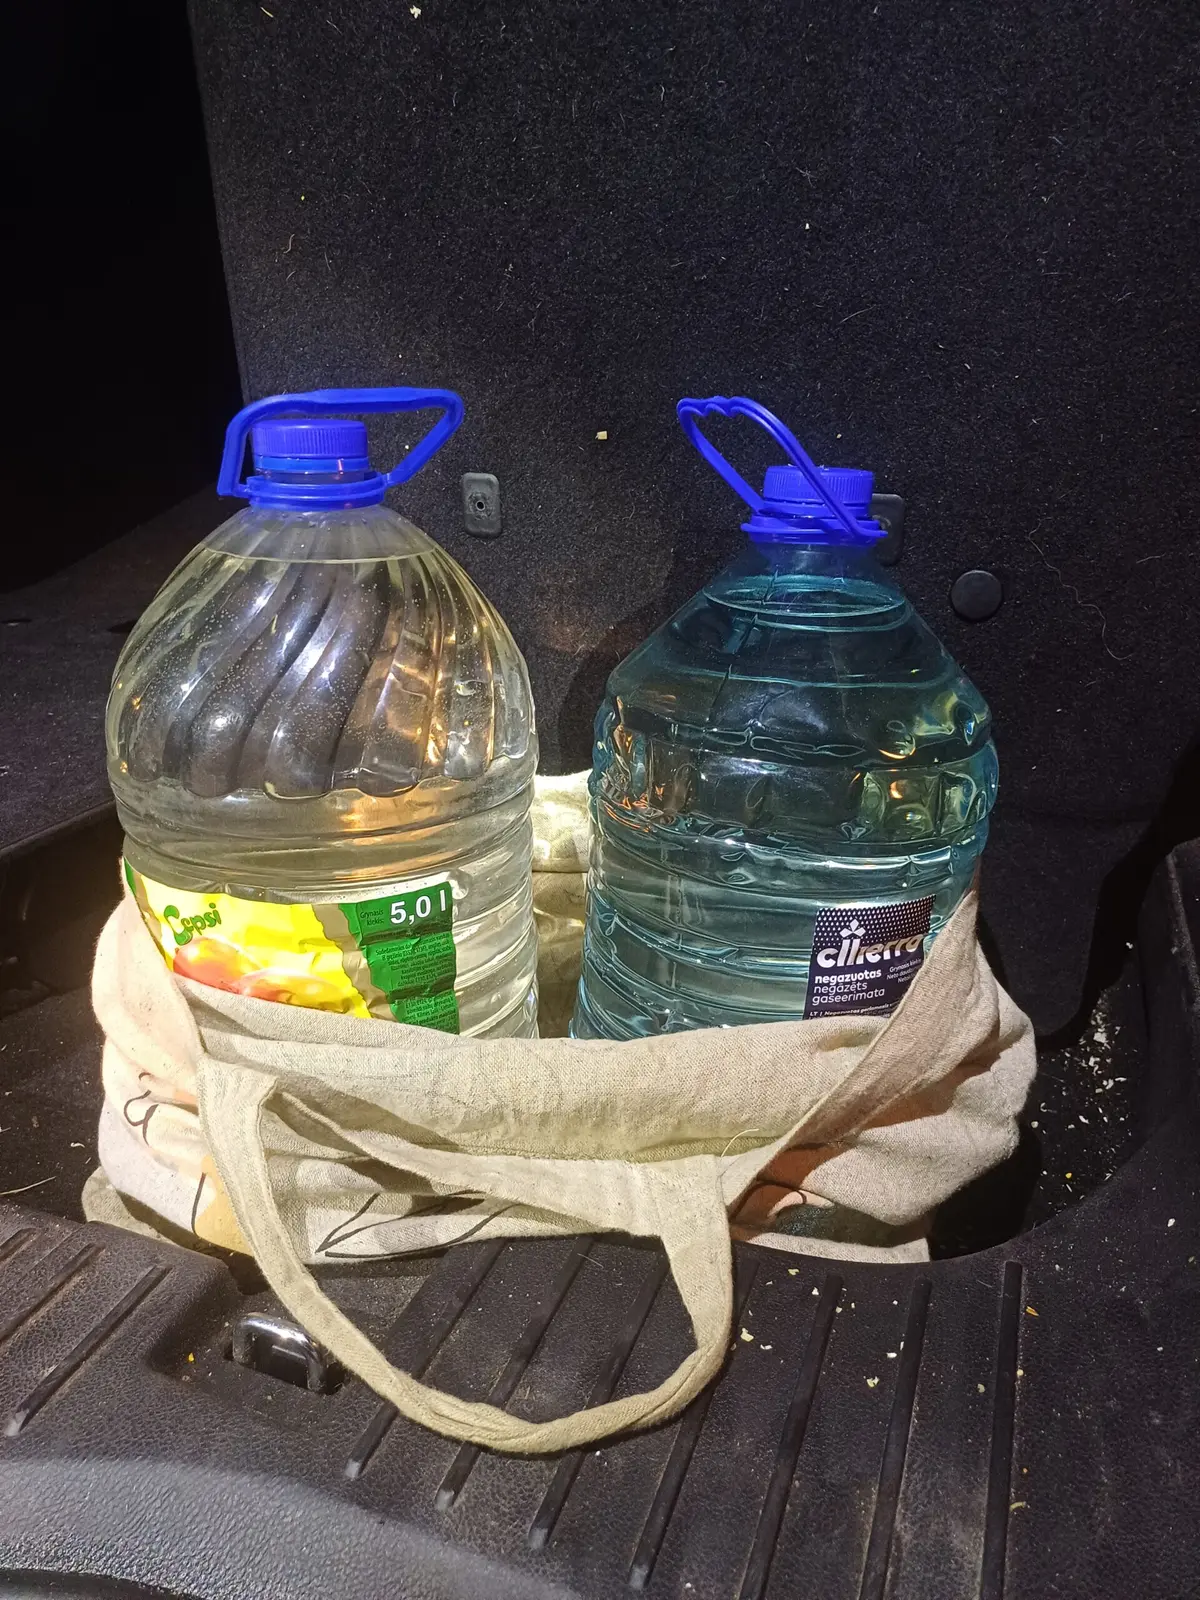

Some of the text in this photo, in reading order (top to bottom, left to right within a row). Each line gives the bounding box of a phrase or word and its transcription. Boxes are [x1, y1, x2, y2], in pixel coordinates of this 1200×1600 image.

[390, 895, 432, 925] 5,0
[814, 968, 882, 985] negazuotas
[811, 987, 886, 1006] gaseerimata
[813, 981, 868, 996] negāzēts
